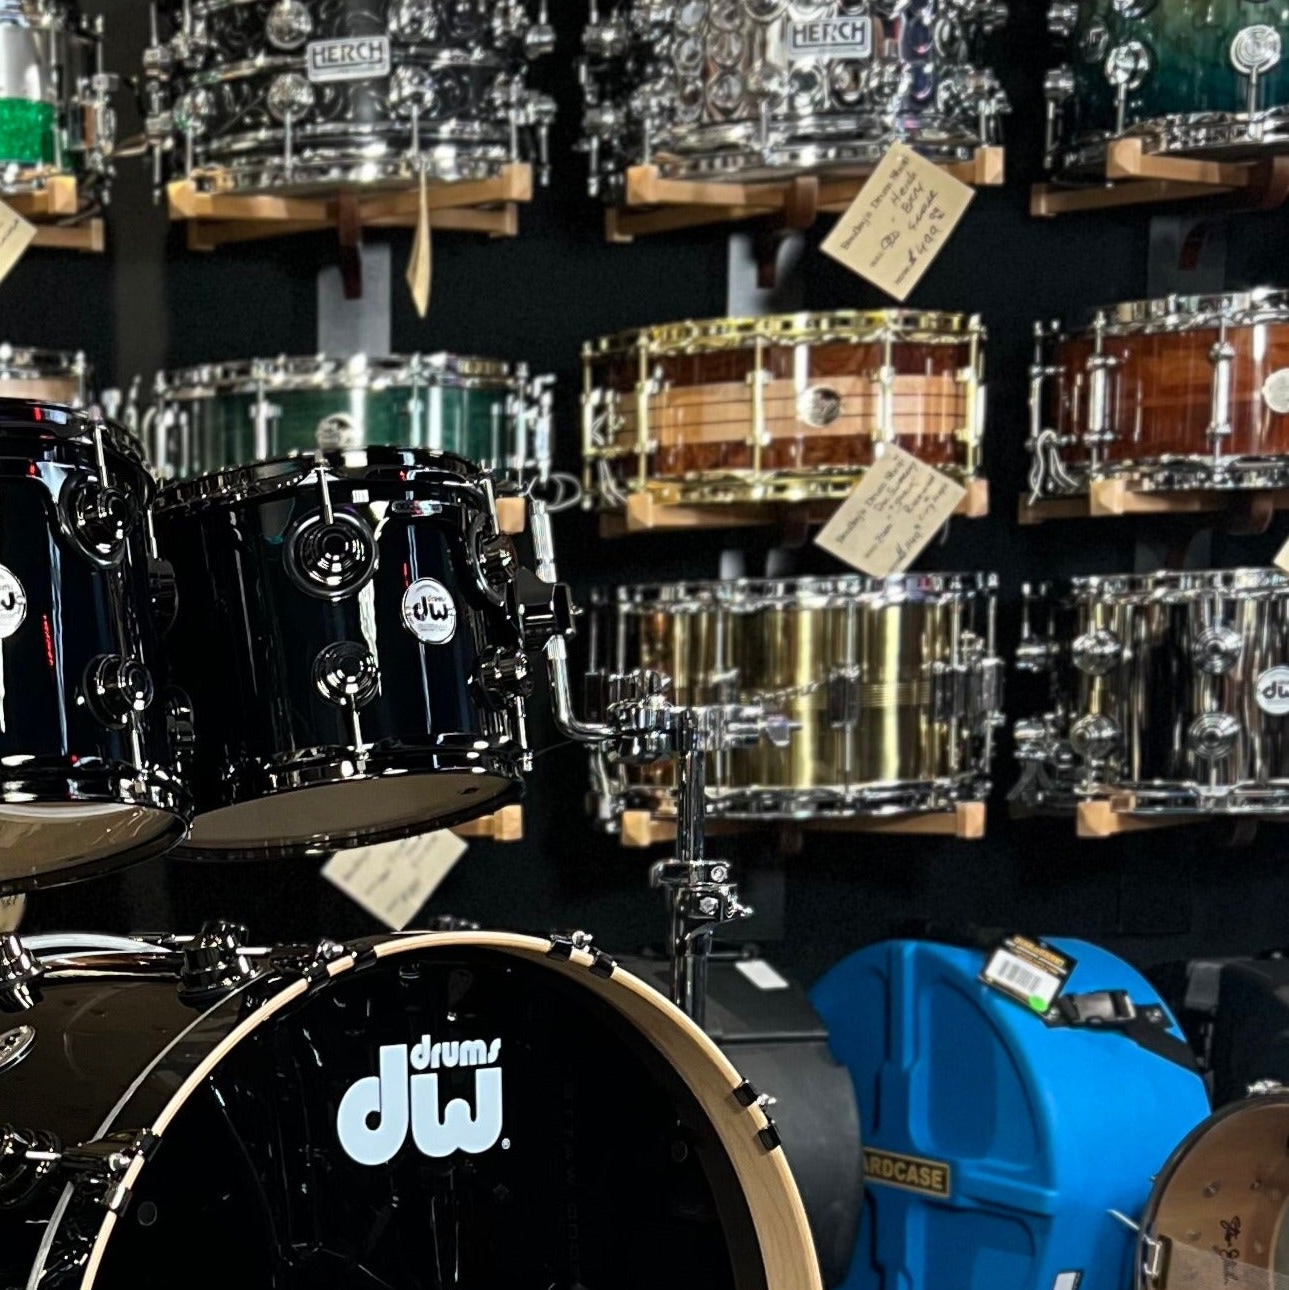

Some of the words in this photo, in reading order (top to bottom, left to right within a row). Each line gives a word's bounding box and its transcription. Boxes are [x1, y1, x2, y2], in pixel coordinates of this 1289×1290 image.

[792, 22, 866, 48] HERCH
[313, 42, 383, 69] HERCH
[413, 596, 449, 621] dw
[410, 1034, 502, 1070] drums
[336, 1043, 503, 1166] dw
